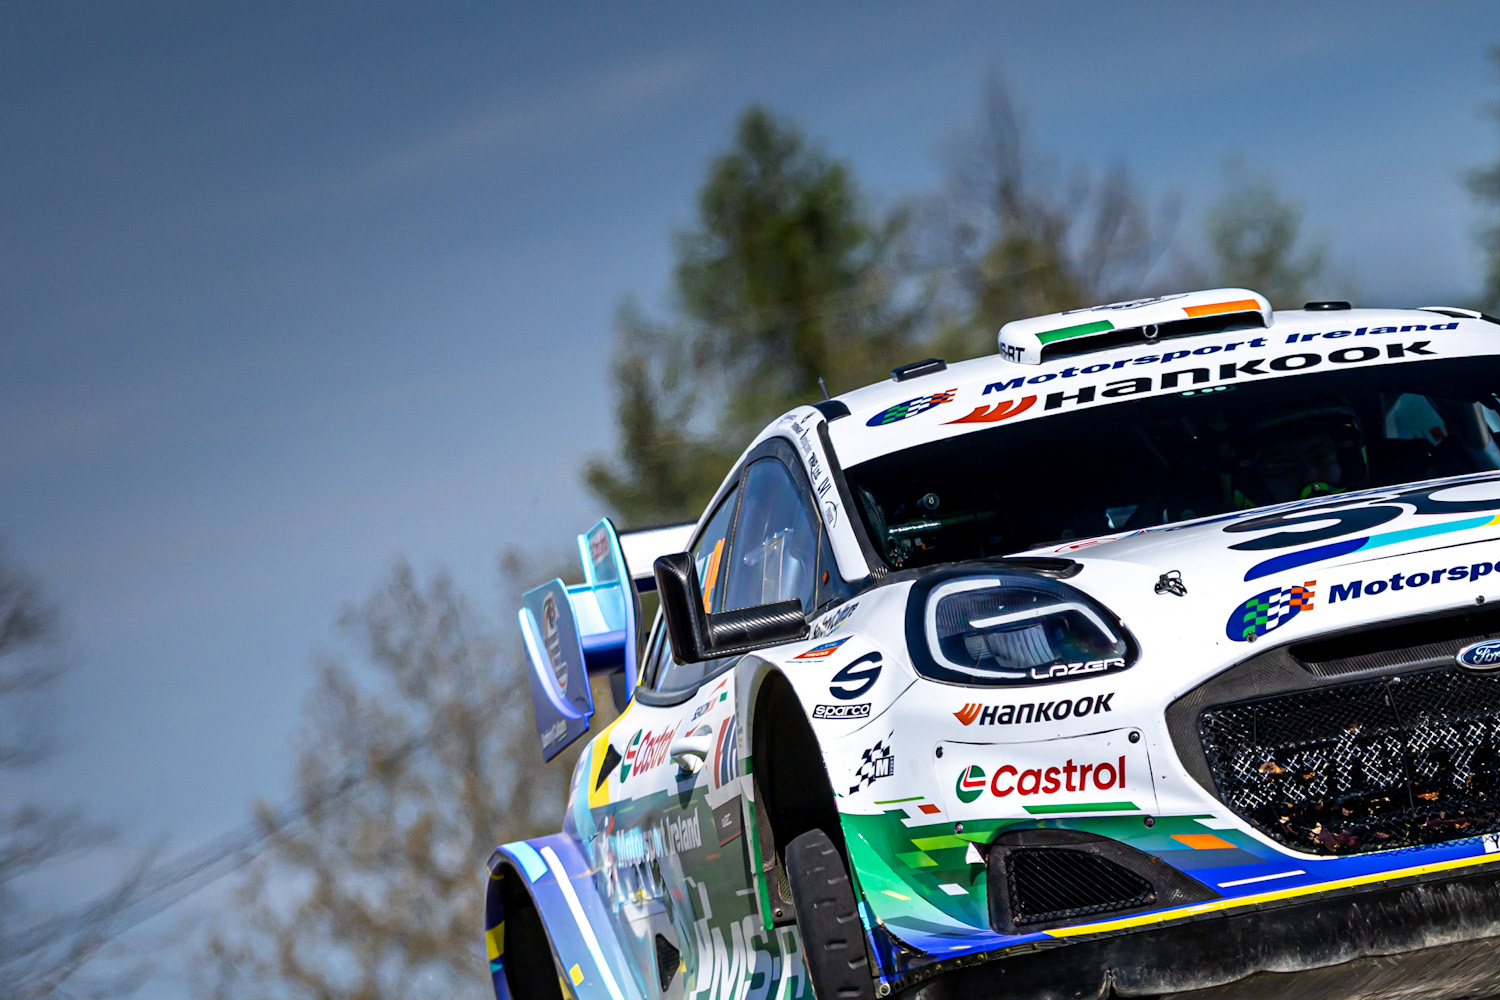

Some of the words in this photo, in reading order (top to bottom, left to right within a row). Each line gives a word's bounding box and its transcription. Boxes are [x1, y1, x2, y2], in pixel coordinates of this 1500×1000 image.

[981, 336, 1268, 396] Motorsport
[1285, 321, 1460, 344] Ireland
[814, 704, 870, 719] sparco
[633, 718, 683, 777] Castrol
[990, 755, 1126, 798] Castrol
[666, 807, 701, 856] Ireland
